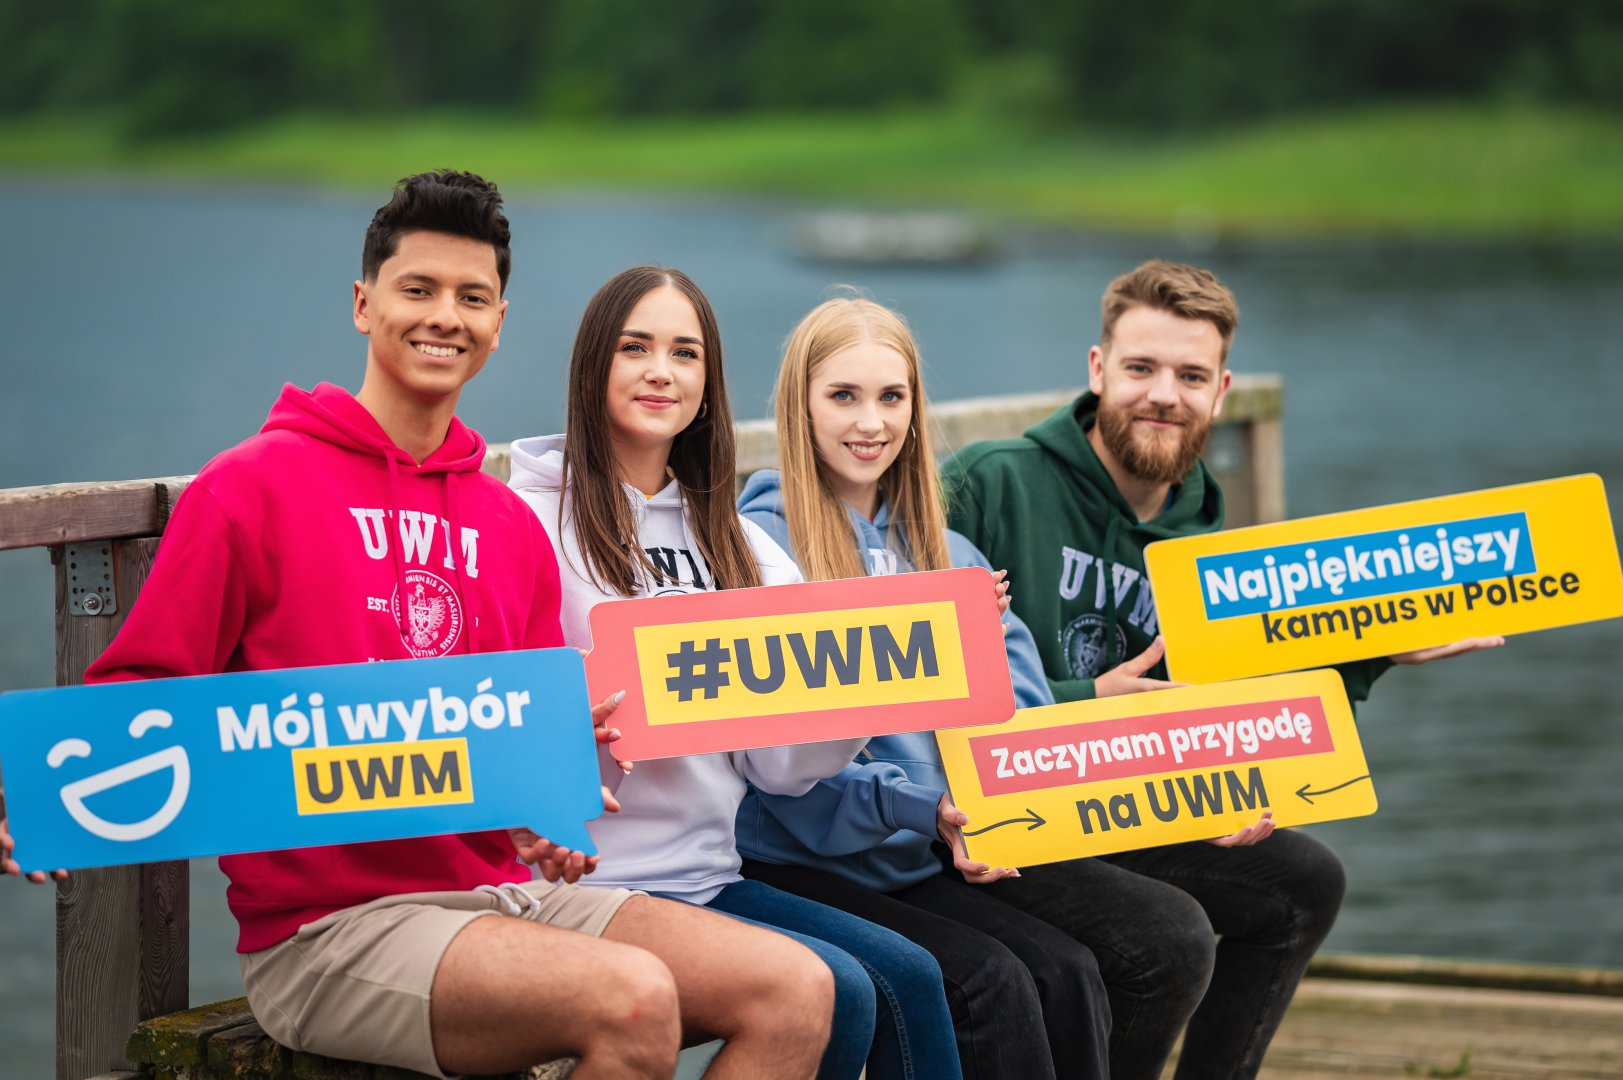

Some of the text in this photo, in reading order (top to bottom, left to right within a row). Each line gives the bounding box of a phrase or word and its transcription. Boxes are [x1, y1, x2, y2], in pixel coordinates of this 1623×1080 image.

[1204, 528, 1520, 608] Najpiękniejszy
[366, 596, 390, 613] EST.
[1261, 571, 1580, 644] kampus w Polsce
[665, 620, 940, 702] #UWM
[216, 677, 530, 752] Mój wybór
[991, 707, 1313, 778] Zaczynam przygodę
[305, 750, 462, 804] UWM
[1075, 766, 1270, 835] na UWM
